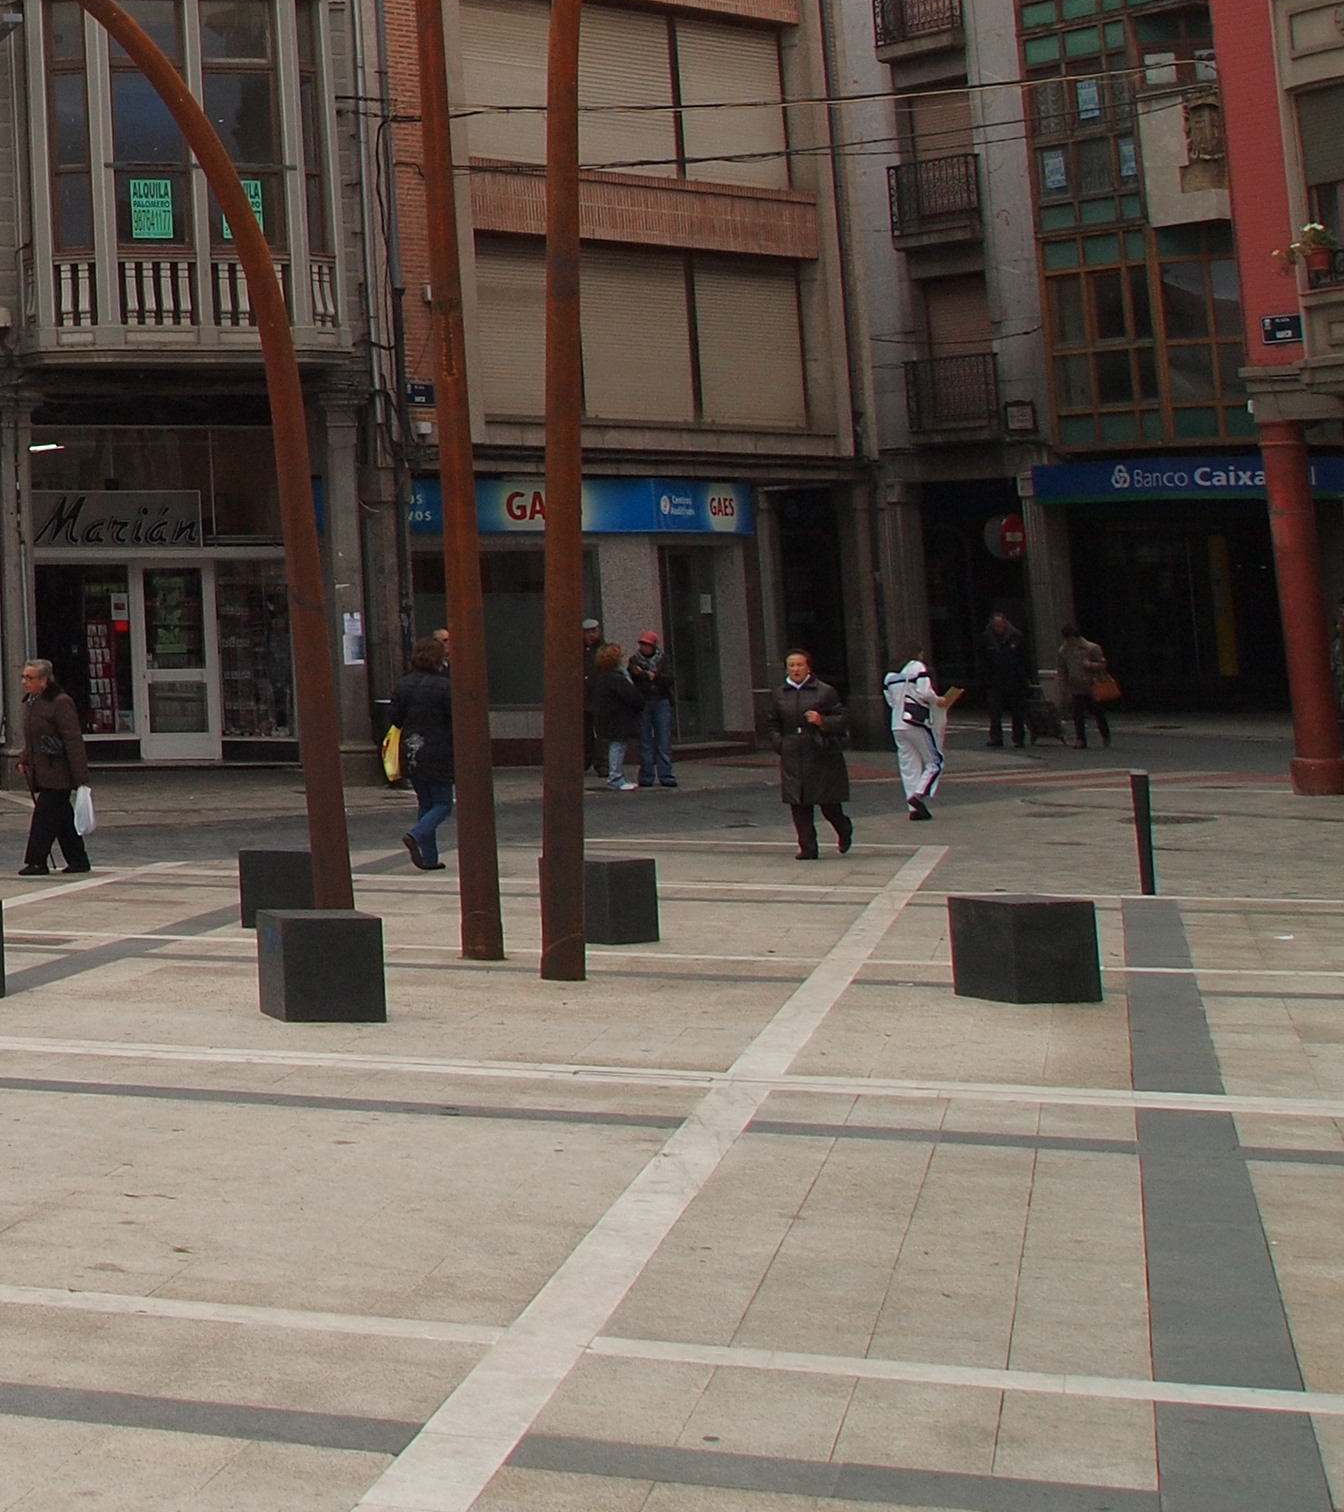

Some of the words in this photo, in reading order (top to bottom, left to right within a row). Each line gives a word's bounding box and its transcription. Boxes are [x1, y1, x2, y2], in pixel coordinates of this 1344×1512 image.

[133, 181, 170, 198] ALQUILA
[1133, 469, 1189, 487] Banco
[709, 497, 735, 517] GAES
[34, 495, 199, 545] Marián
